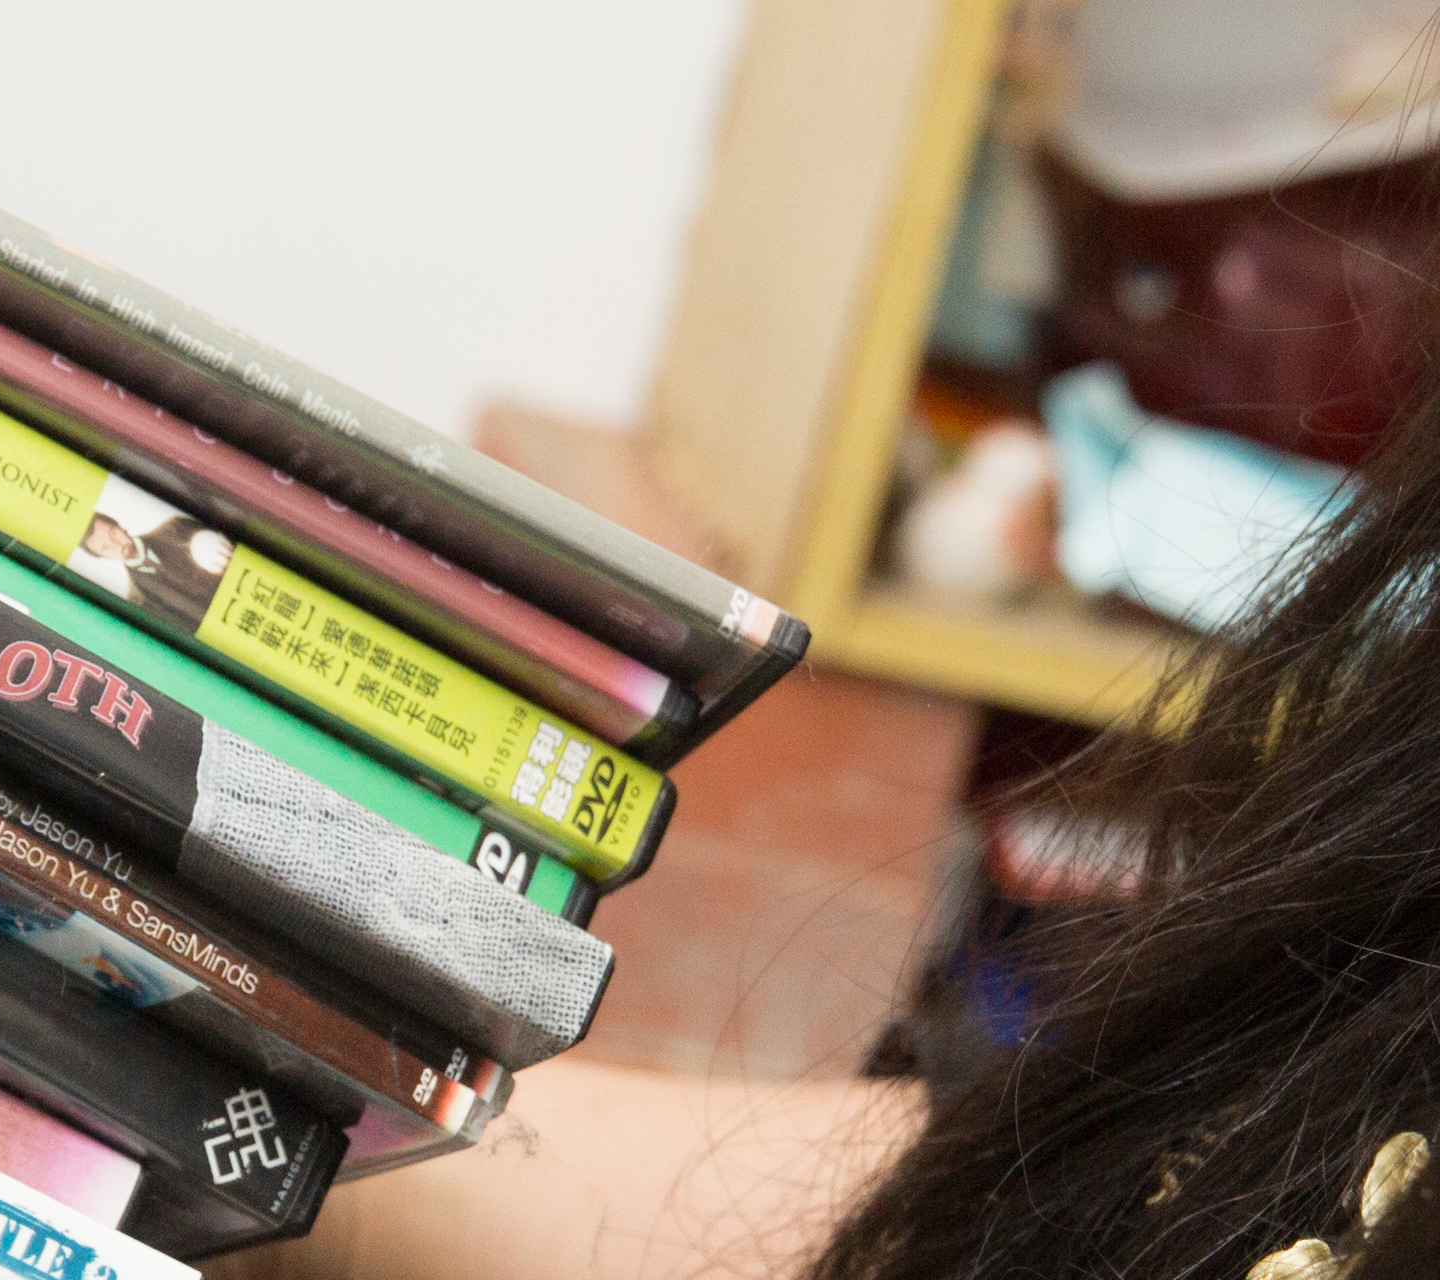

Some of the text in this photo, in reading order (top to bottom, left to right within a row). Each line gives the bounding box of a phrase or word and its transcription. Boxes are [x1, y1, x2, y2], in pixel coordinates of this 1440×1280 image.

[104, 292, 160, 338] High
[160, 319, 236, 376] Impact
[239, 360, 294, 405] Coin
[295, 389, 364, 440] Magic
[568, 753, 621, 837] DVD
[607, 785, 642, 848] VIDEO
[17, 800, 98, 861] Jason
[92, 843, 138, 883] Yu
[56, 860, 102, 901] Yu
[99, 886, 127, 916] &
[122, 898, 264, 997] SansMinds
[410, 1067, 435, 1103] DVD
